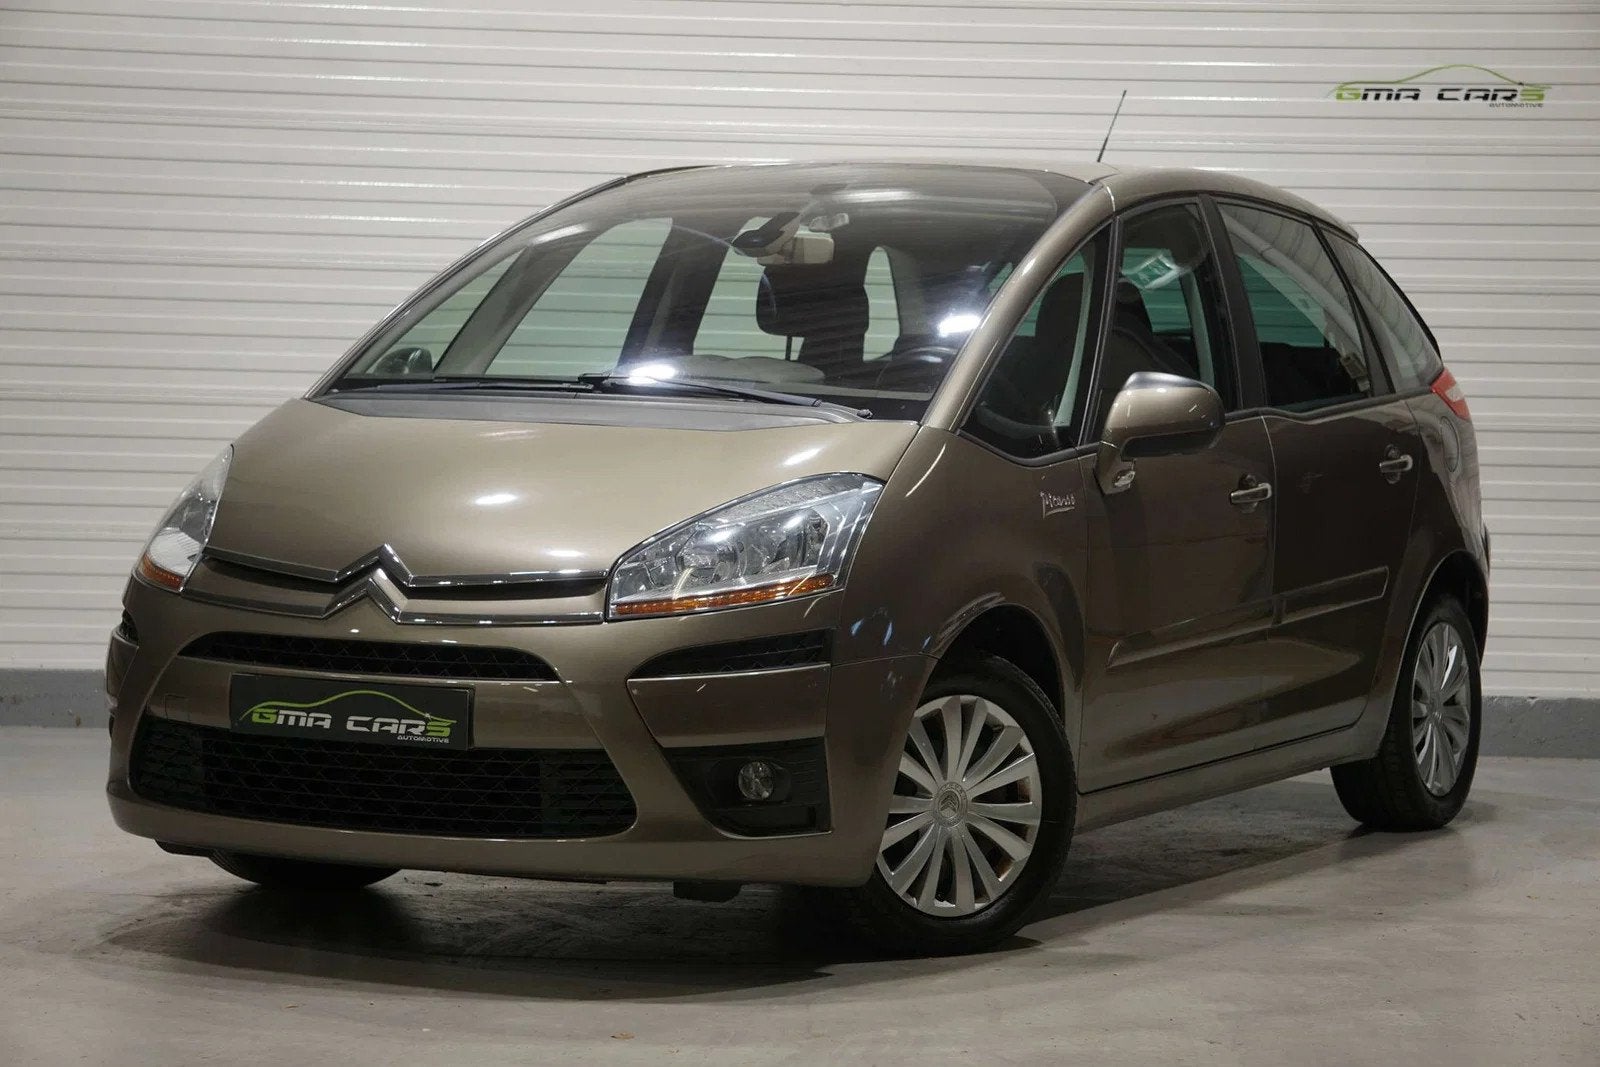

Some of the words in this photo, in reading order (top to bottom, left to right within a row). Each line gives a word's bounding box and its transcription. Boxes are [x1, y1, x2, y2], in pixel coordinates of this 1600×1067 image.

[1335, 87, 1421, 101] GMA
[1437, 87, 1545, 101] CARS
[252, 708, 332, 729] GMA
[346, 715, 451, 737] CARS
[397, 735, 450, 743] AUTOMOTIVE
